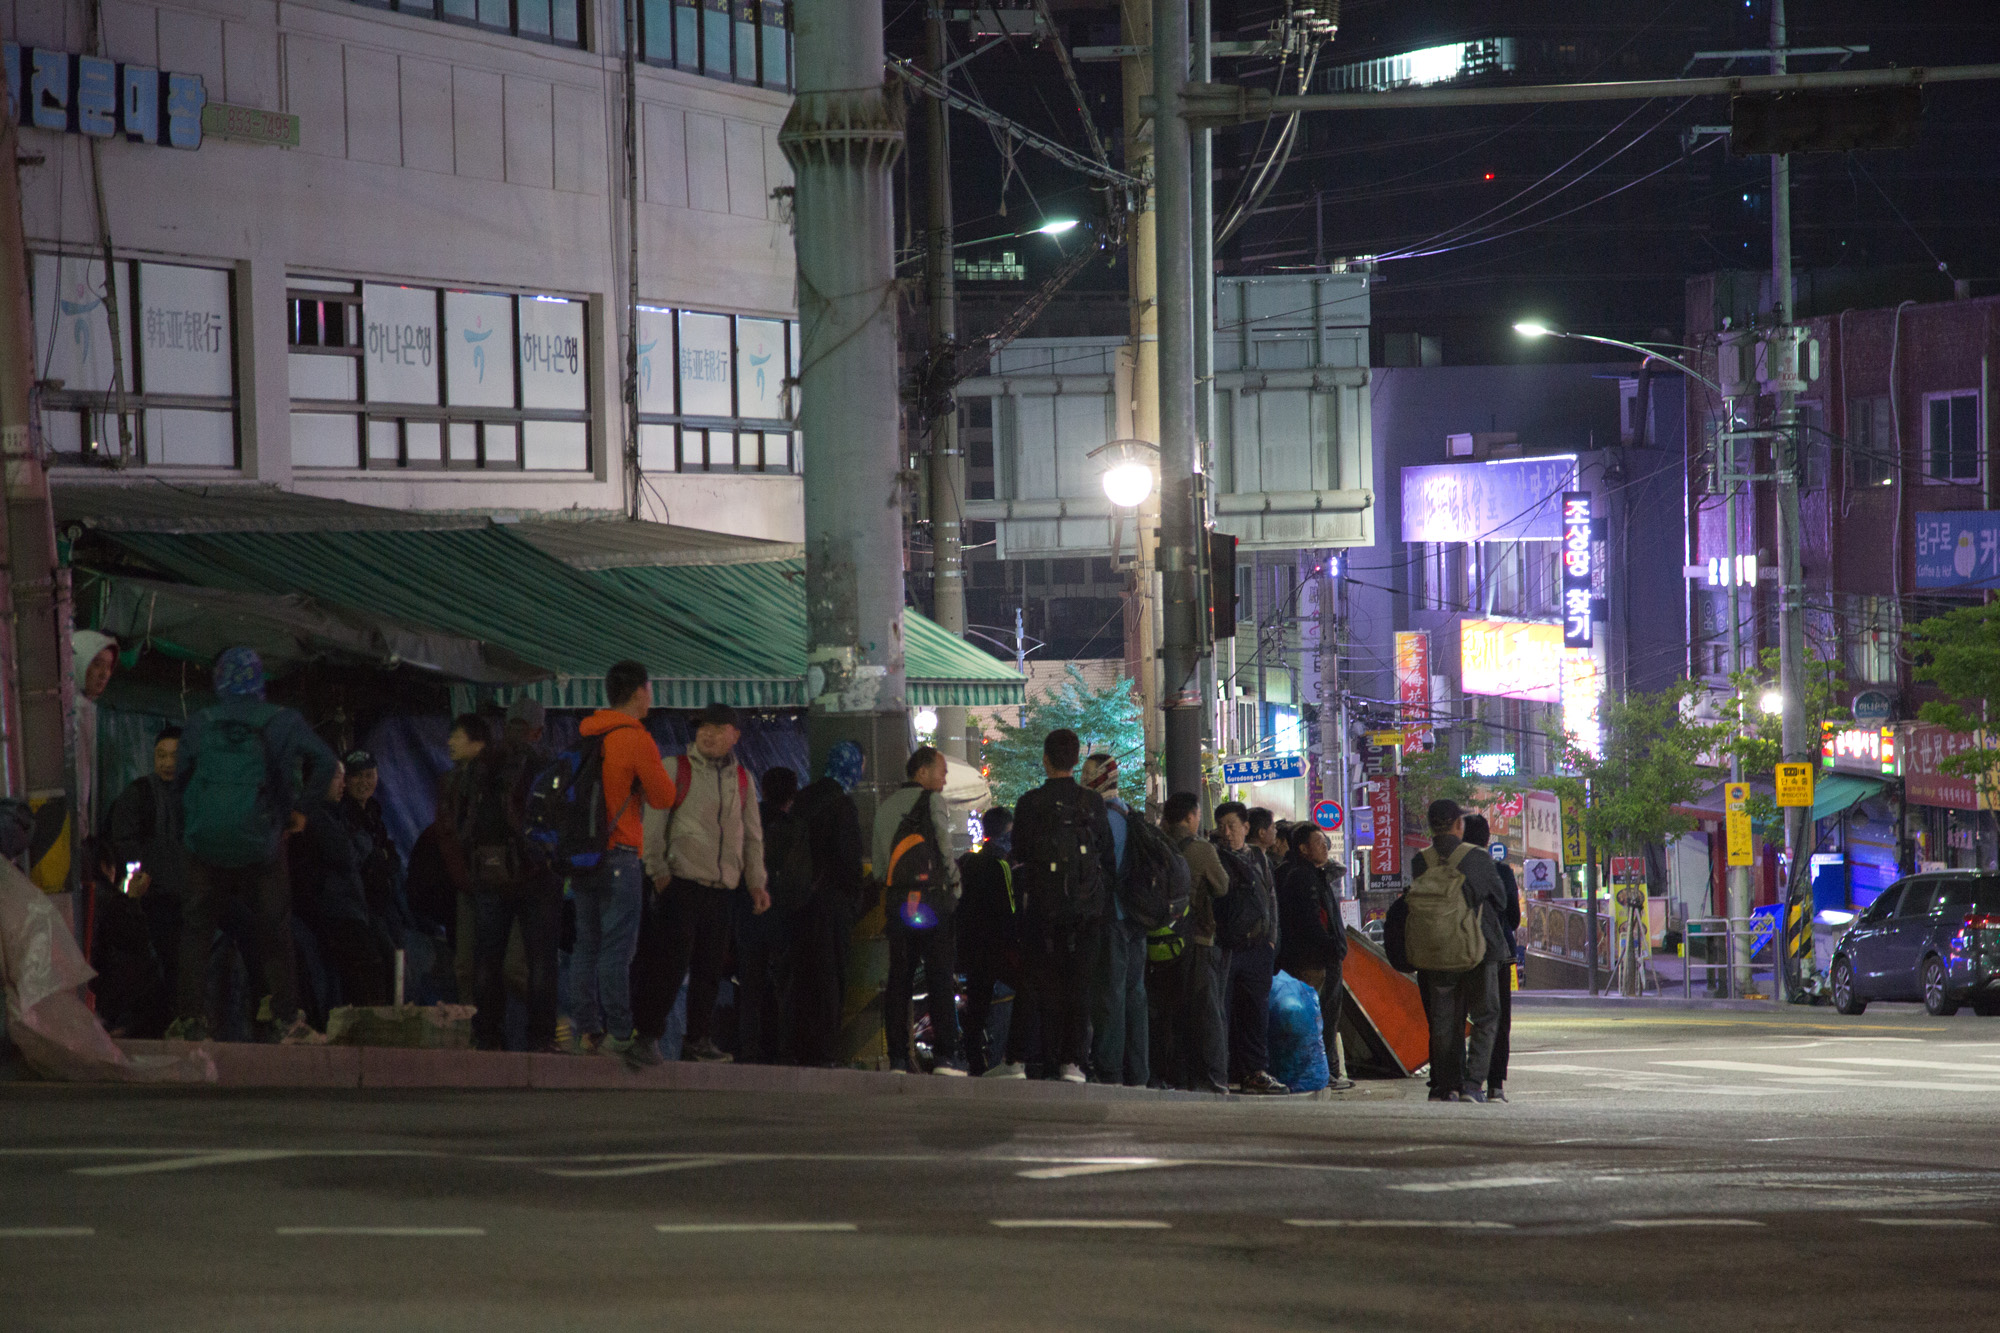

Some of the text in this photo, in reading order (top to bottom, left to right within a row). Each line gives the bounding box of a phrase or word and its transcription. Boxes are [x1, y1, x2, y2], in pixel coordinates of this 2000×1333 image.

[146, 306, 223, 354] 韩亚银行
[369, 322, 431, 367] 하나은행
[523, 332, 578, 374] 하나은행
[680, 347, 728, 382] 韩亚银行
[1565, 500, 1592, 577] 조상땅
[1917, 522, 2000, 576] 남구로 커
[1566, 588, 1592, 640] 찾기
[1226, 758, 1289, 774] 구로동로3길
[1226, 773, 1262, 783] Gurodong-ro
